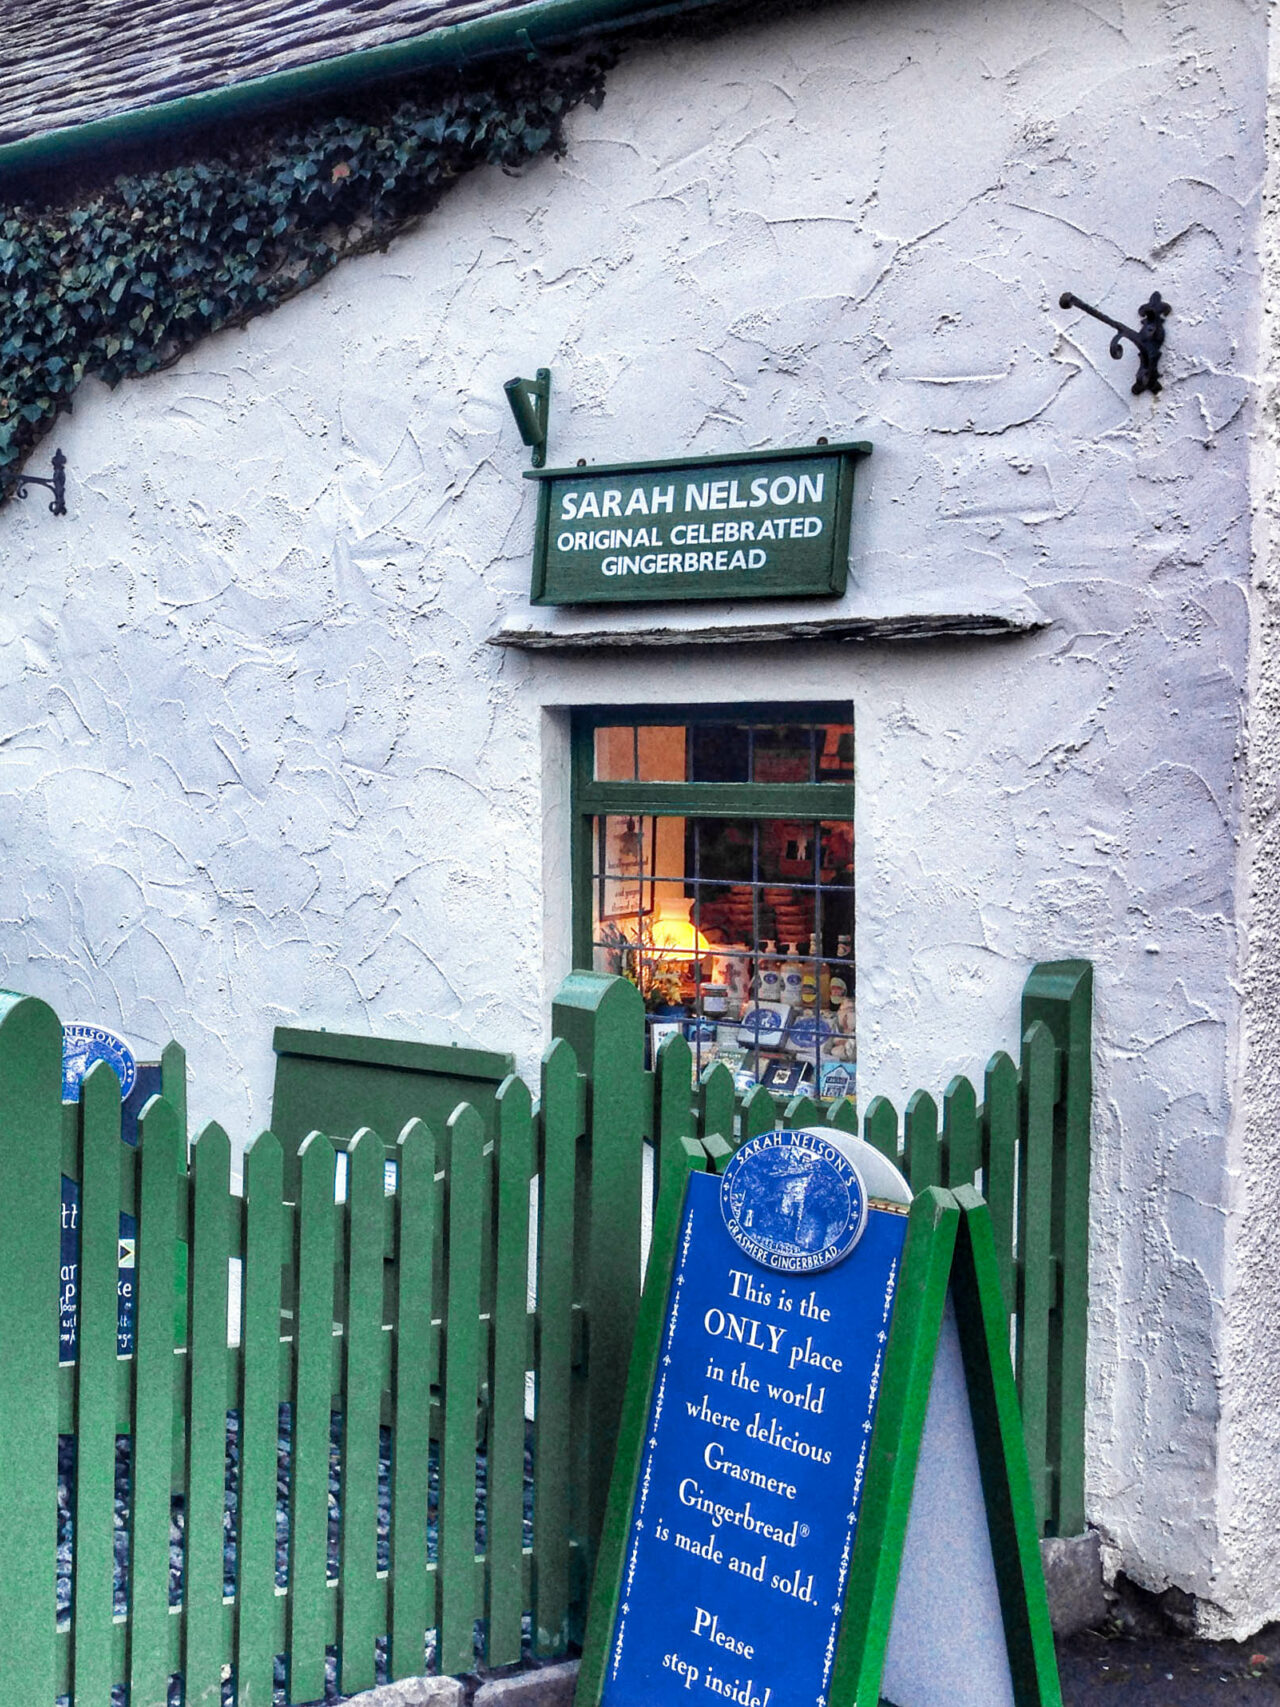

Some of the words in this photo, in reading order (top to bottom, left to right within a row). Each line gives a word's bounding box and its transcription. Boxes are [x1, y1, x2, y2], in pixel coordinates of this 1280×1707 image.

[561, 485, 675, 521] SARAH
[685, 473, 825, 512] NELSON
[557, 527, 663, 552] ORIGINAL
[670, 516, 823, 546] CELEBRATED
[601, 548, 767, 576] GINGERBREAD
[736, 1132, 782, 1165] SARAH
[790, 1132, 857, 1188] NELSON'S
[727, 1218, 769, 1263] GRASMERE
[770, 1245, 839, 1270] GINGERBREAD
[728, 1269, 772, 1306] This
[777, 1288, 793, 1312] is
[800, 1291, 831, 1322] the
[704, 1307, 788, 1355] ONLY
[788, 1336, 843, 1373] place
[705, 1357, 725, 1382] in
[730, 1361, 760, 1393] the
[767, 1382, 826, 1414] world
[685, 1394, 741, 1432] where
[745, 1412, 832, 1465] delicious
[704, 1441, 797, 1500] Grasmere
[655, 1517, 670, 1541] is
[674, 1534, 724, 1564] made
[728, 1555, 767, 1583] and
[770, 1569, 818, 1607] sold.
[690, 1606, 755, 1660] Please
[662, 1652, 699, 1690] step
[704, 1666, 771, 1707] inside!
